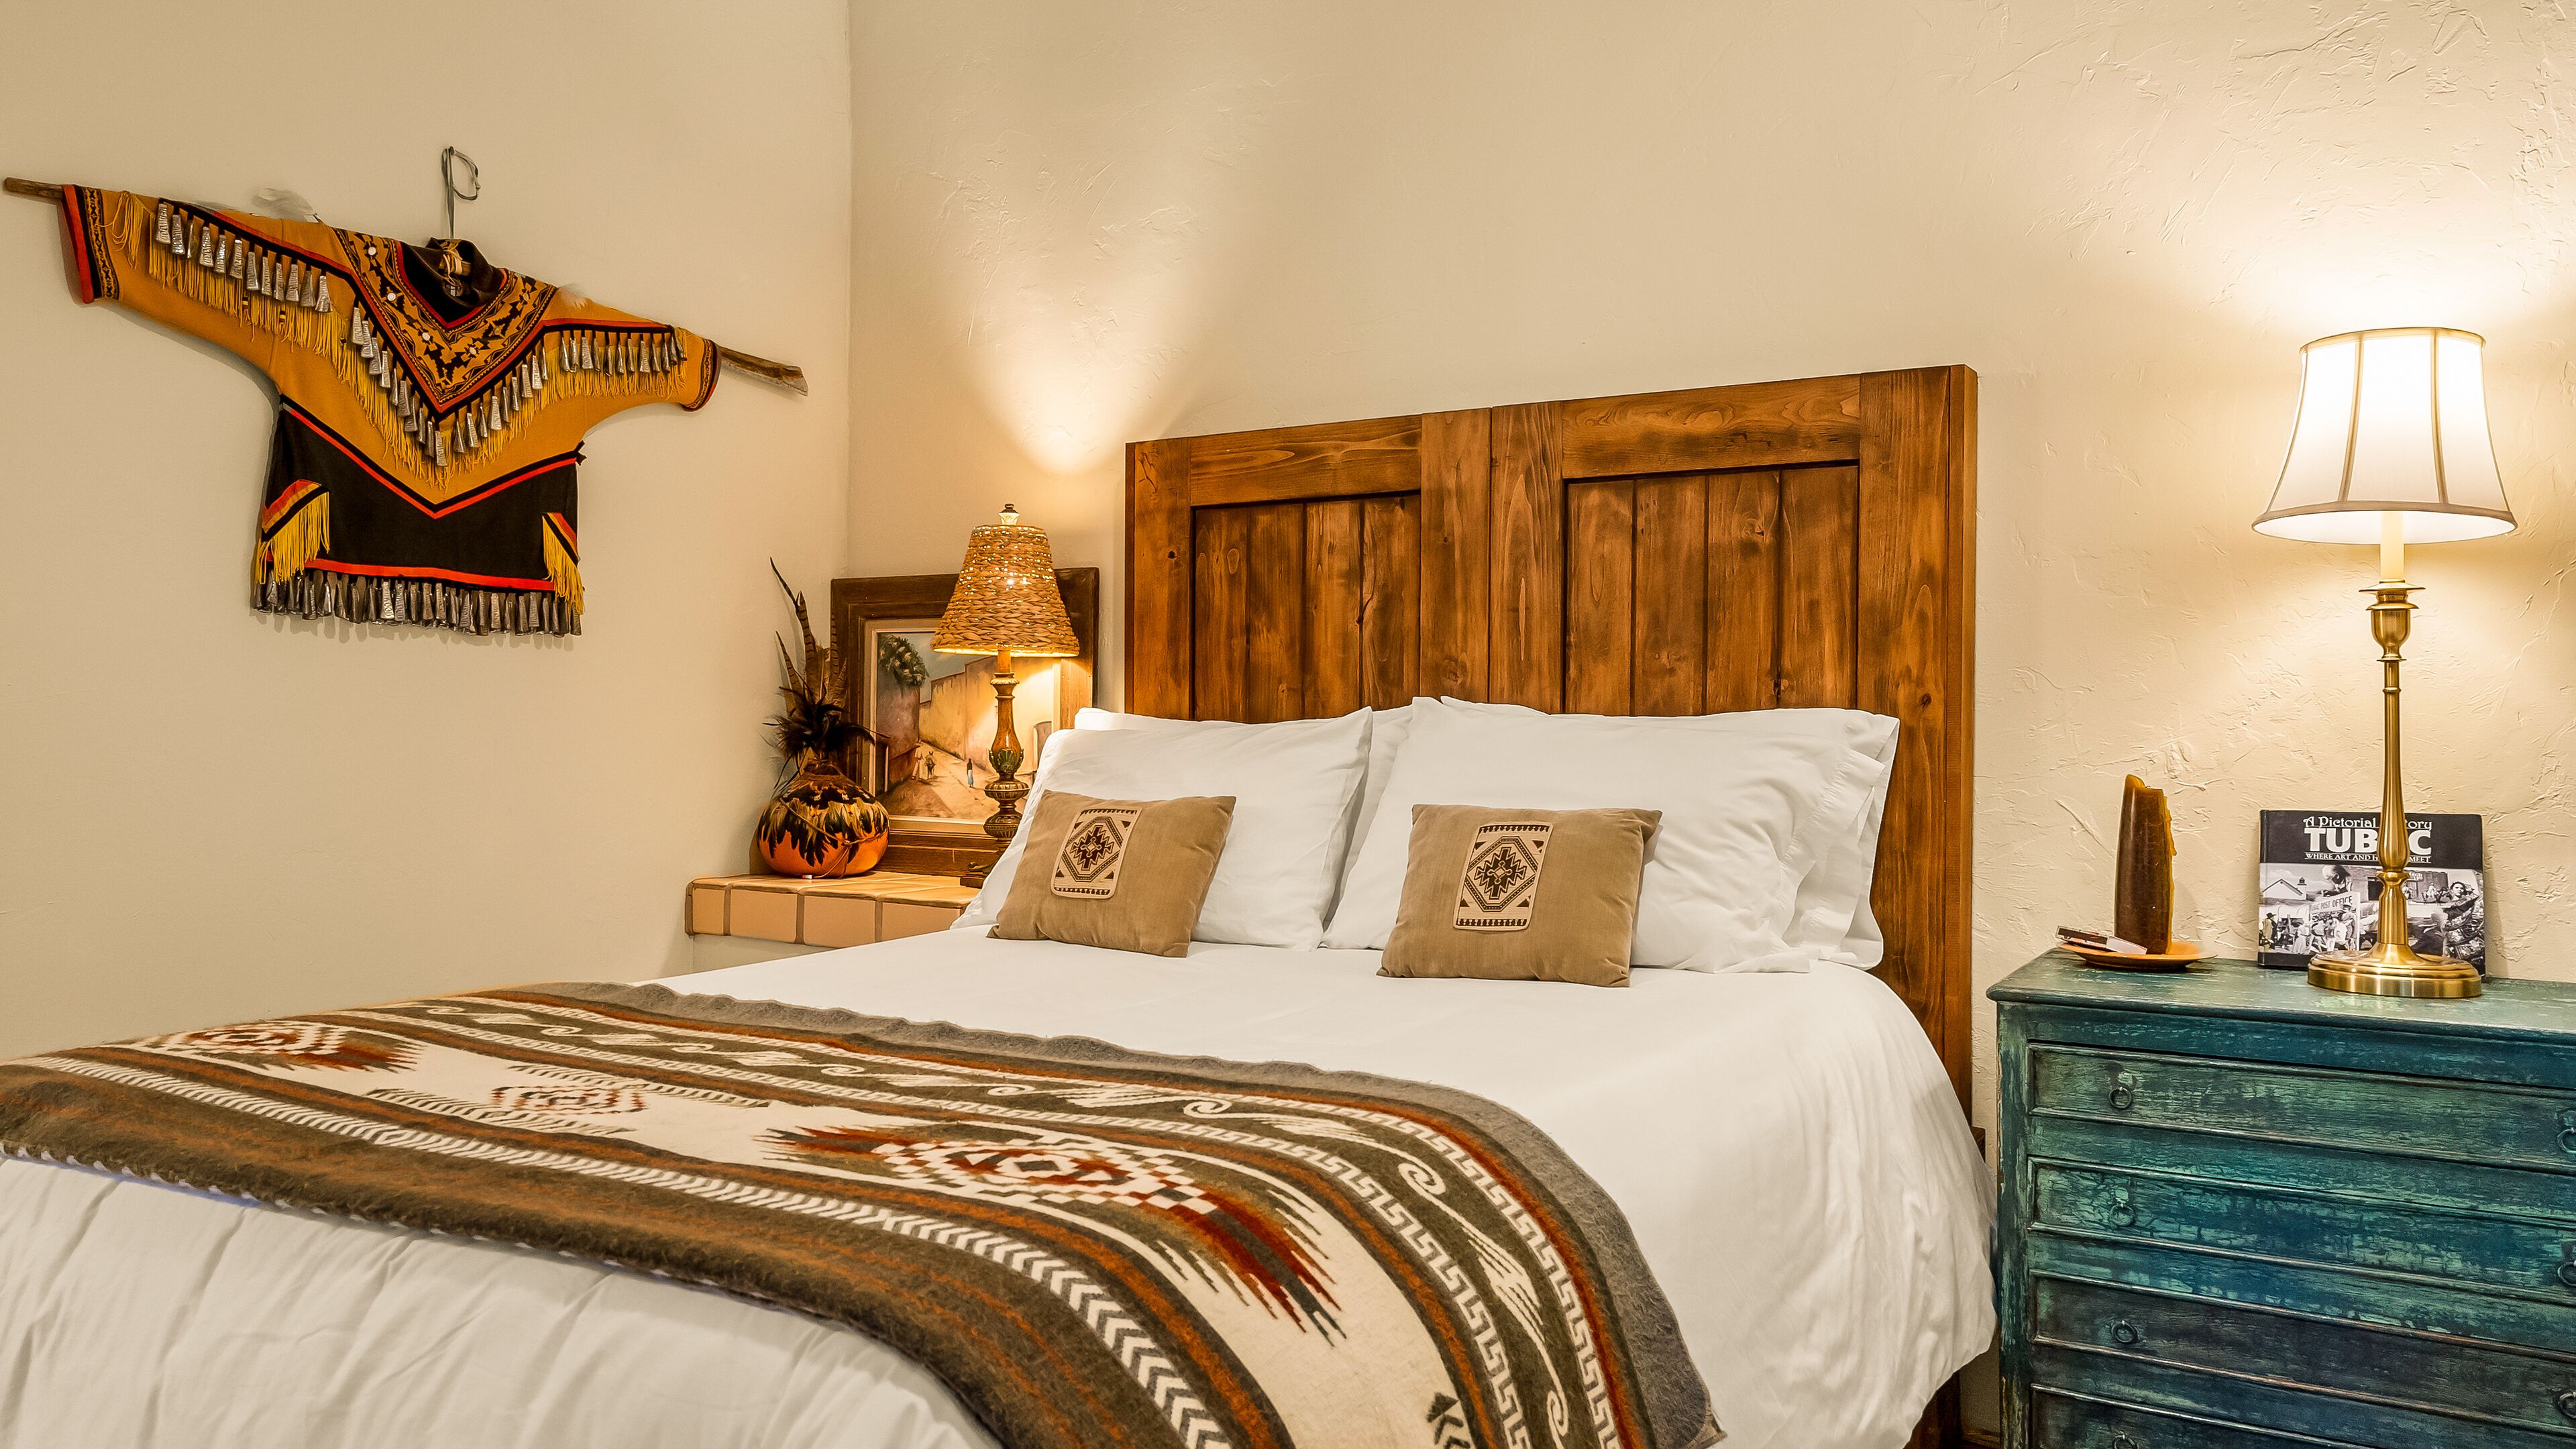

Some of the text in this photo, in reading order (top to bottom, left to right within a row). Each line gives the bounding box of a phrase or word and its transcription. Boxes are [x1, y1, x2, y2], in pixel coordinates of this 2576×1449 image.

[2303, 816, 2314, 828] A
[2318, 816, 2376, 828] Pictorial
[2304, 827, 2432, 855] TUBC
